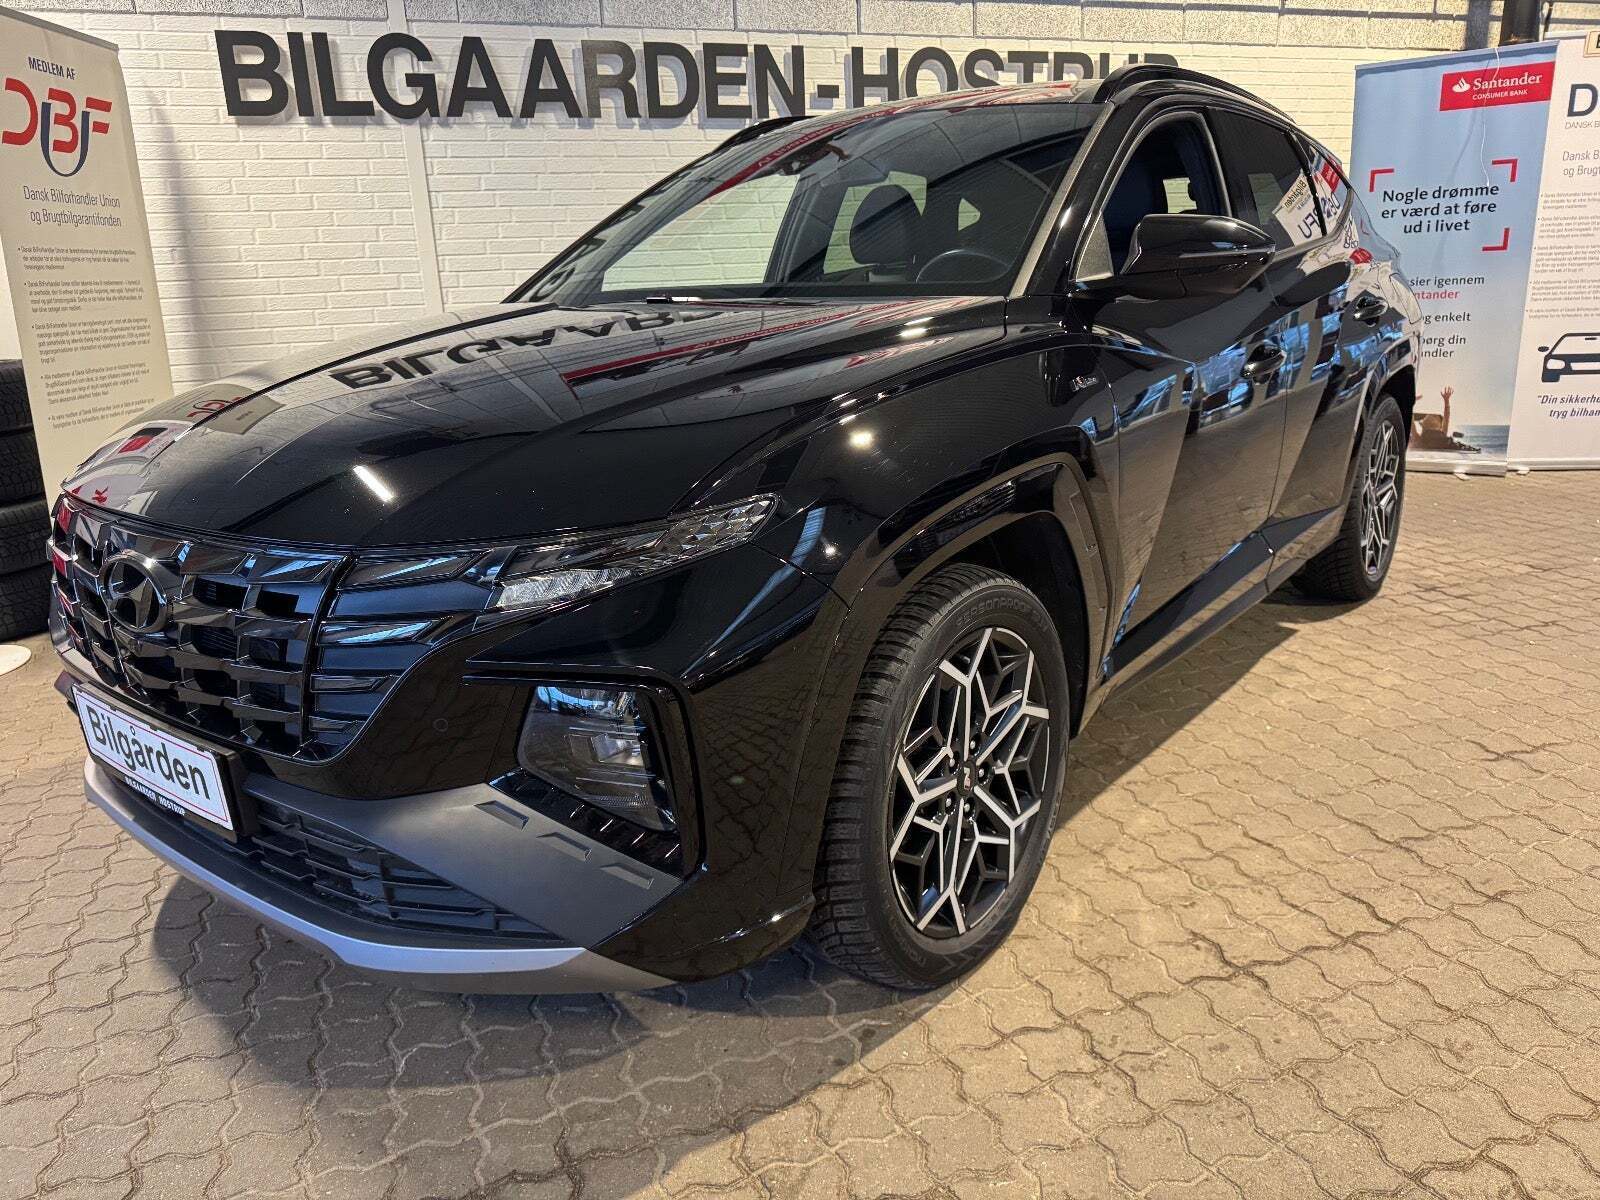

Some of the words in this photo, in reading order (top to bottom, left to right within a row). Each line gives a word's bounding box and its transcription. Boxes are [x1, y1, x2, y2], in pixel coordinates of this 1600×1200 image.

[28, 56, 64, 78] MEDLEM
[66, 67, 76, 81] AF
[1473, 72, 1543, 91] Santander
[1472, 90, 1509, 101] CONSUMER
[1510, 88, 1528, 98] BANK
[1565, 120, 1594, 129] DANSK
[1562, 150, 1591, 161] Dansk
[1563, 167, 1575, 178] og
[23, 185, 50, 202] Dansk
[50, 188, 98, 206] Bilforhandler
[100, 193, 121, 208] Union
[1383, 187, 1428, 205] Nogle
[1432, 185, 1500, 200] drømme
[1381, 207, 1397, 219] er
[1401, 202, 1439, 217] værd
[1441, 204, 1460, 216] at
[1464, 200, 1497, 215] føre
[30, 210, 41, 226] og
[1403, 221, 1424, 234] ud
[1426, 220, 1431, 232] i
[1435, 218, 1470, 231] livet
[1409, 277, 1431, 286] sier
[1434, 276, 1485, 288] igennem
[1414, 289, 1460, 300] ntander
[1435, 312, 1471, 322] enkelt
[1448, 335, 1466, 345] din
[1549, 409, 1569, 419] tryg
[86, 705, 210, 800] Bilgården
